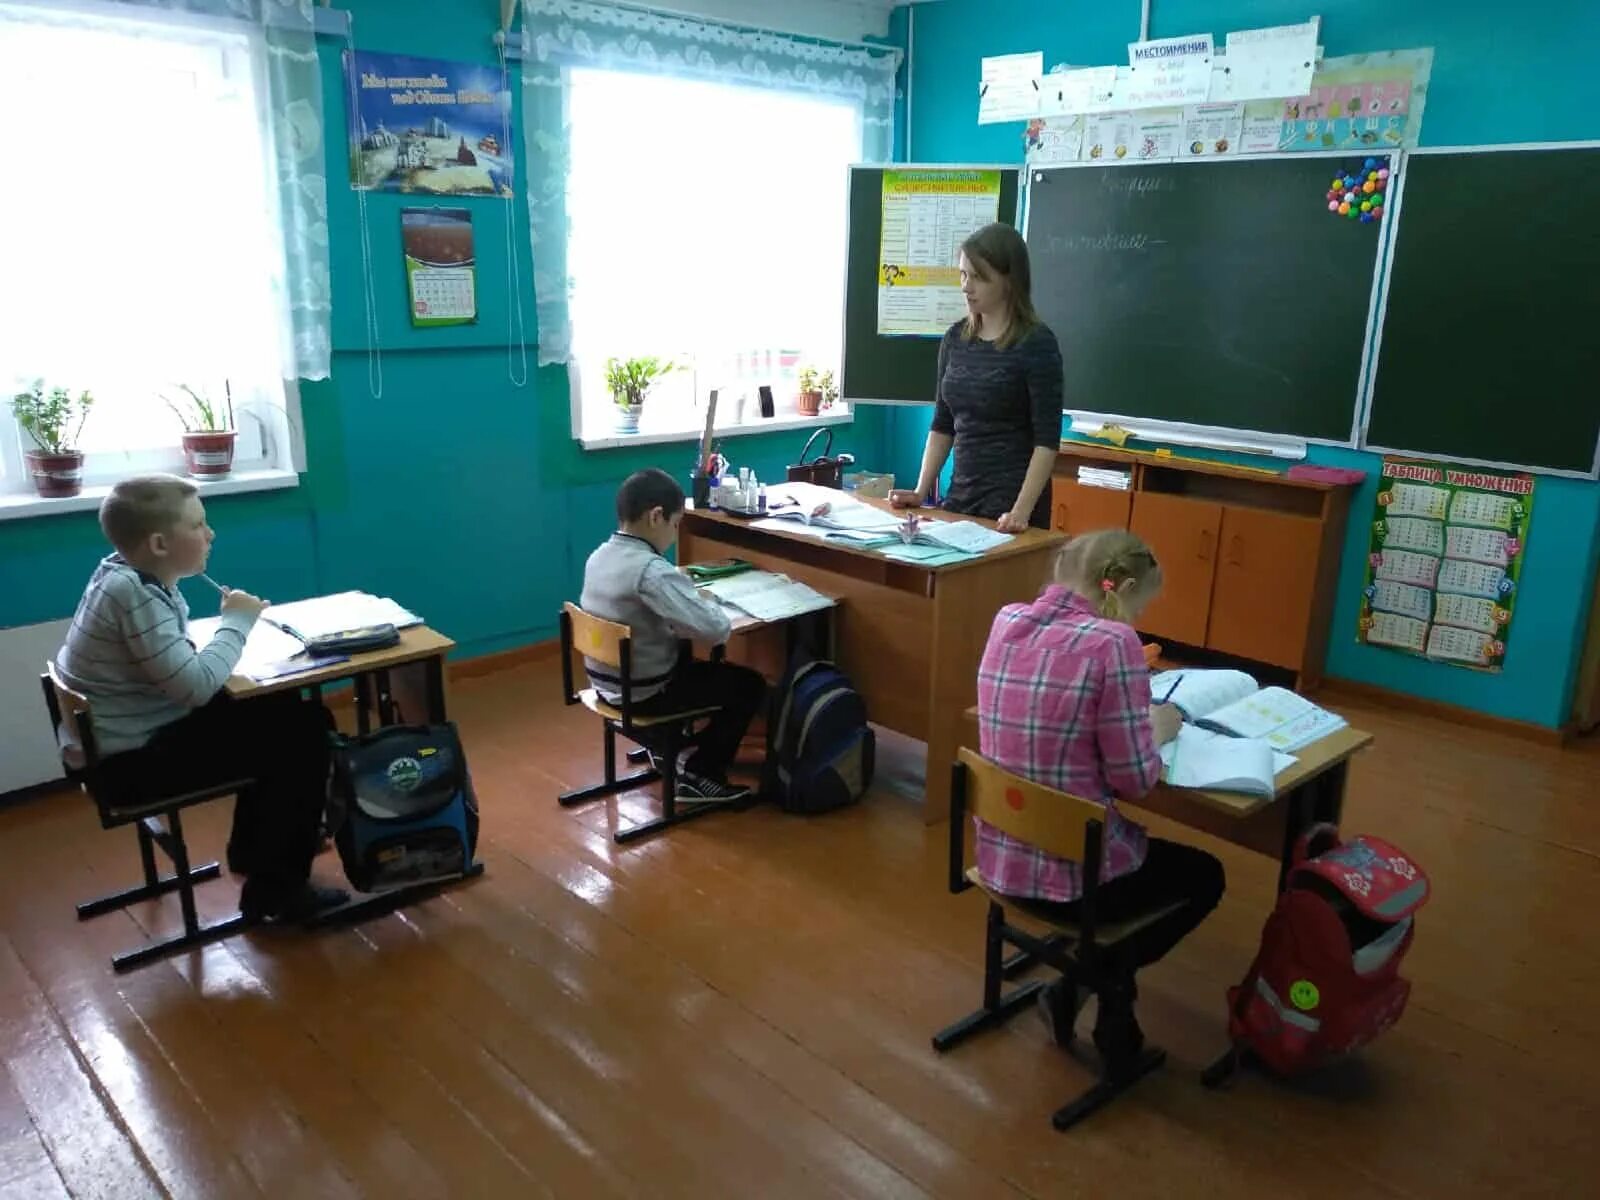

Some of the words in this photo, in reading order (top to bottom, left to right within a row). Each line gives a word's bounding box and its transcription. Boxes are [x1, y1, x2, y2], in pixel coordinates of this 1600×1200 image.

[1135, 42, 1208, 58] МЕСТОИМЕНИЯ
[1383, 462, 1443, 484] ТАБЛИЦА
[1446, 471, 1533, 494] УМНОЖЕНИЯ
